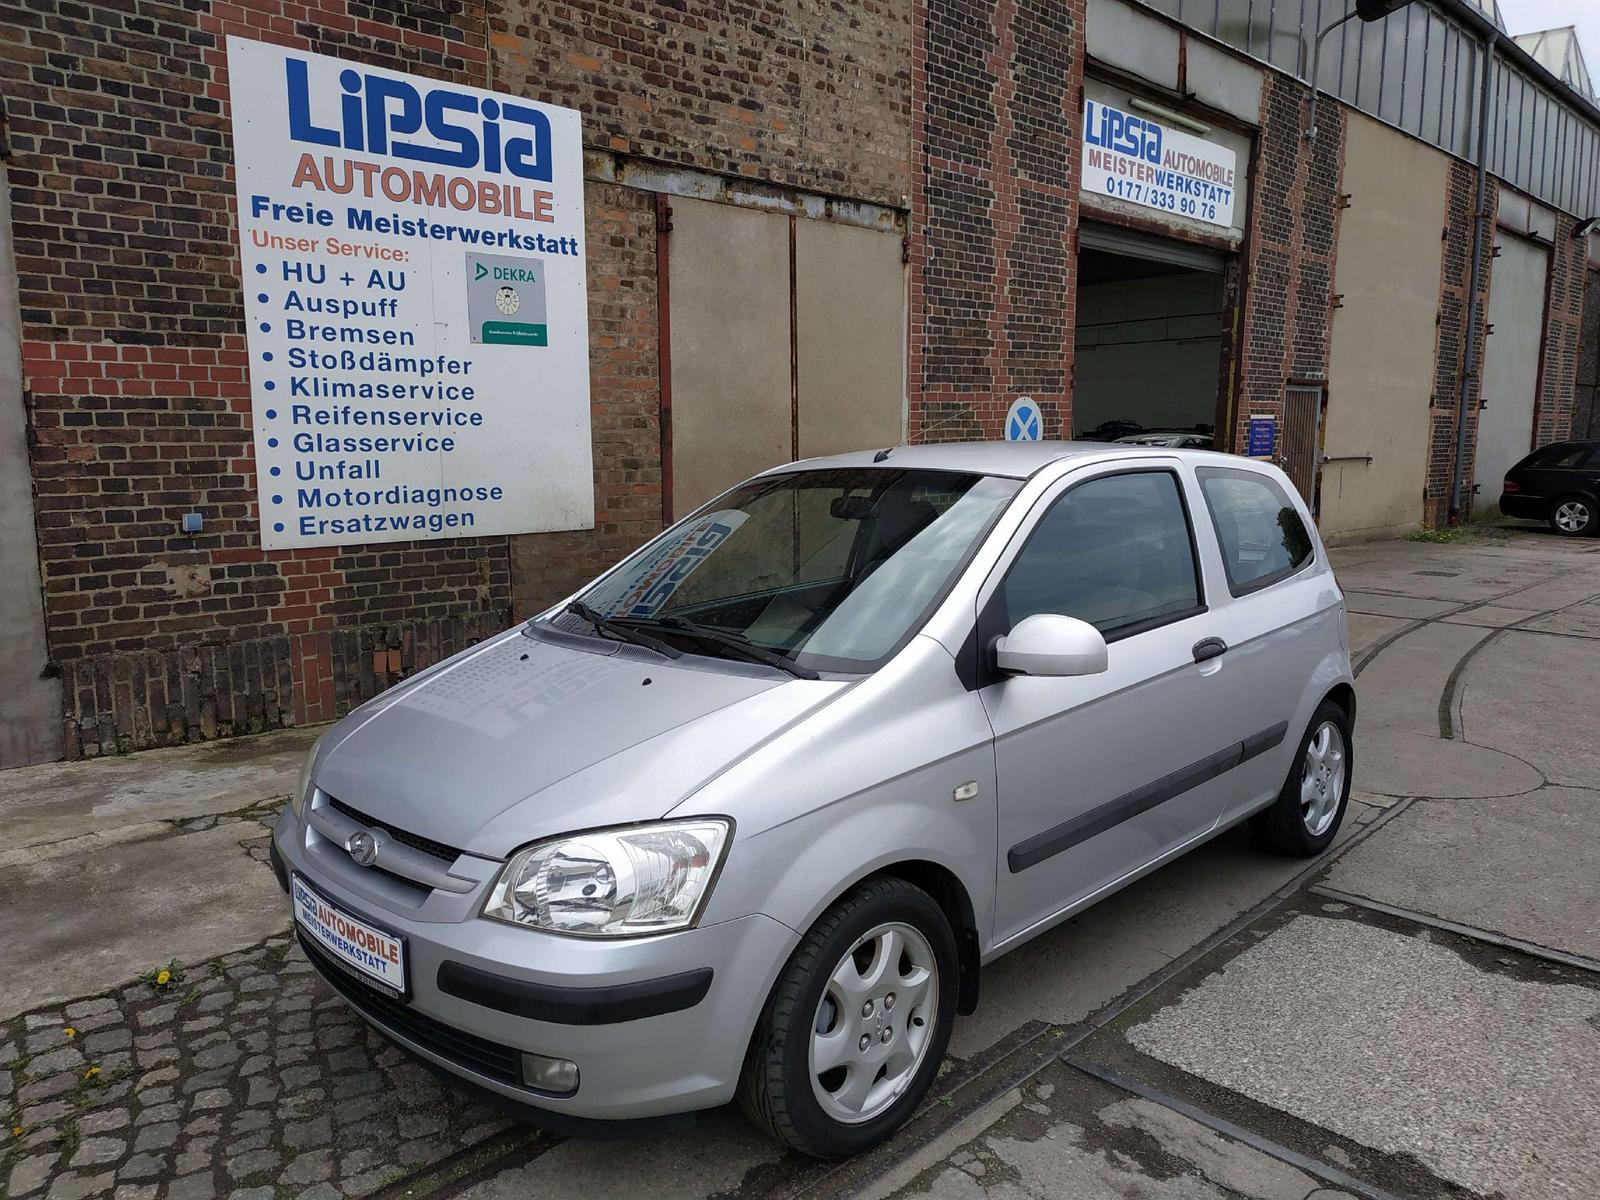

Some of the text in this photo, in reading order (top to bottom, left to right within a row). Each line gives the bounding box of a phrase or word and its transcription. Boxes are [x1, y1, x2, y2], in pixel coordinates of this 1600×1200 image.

[1088, 148, 1231, 205] MEISTERWERKSTATT
[1163, 149, 1233, 187] AUTOMOBILE
[291, 153, 555, 223] AUTOMOBILE
[1180, 197, 1196, 215] 90
[1201, 202, 1216, 220] 76
[251, 195, 579, 256] Freie Meisterwerkstatt
[252, 229, 410, 263] Unser Service:
[282, 260, 326, 285] HU
[366, 269, 406, 291] AU
[493, 266, 536, 283] DEKRA
[283, 290, 399, 319] Auspuff
[286, 318, 415, 346] Bremsen
[288, 347, 473, 377] Stoßdämpfer
[290, 376, 475, 401] Klimaservice
[291, 404, 484, 426] Reifenservice
[293, 432, 456, 453] Glasservice
[295, 459, 381, 481] Unfall
[297, 485, 503, 509] Motordiagnose
[299, 510, 476, 536] Ersatzwagen
[302, 908, 388, 974] MEISTERWERKSTATT
[318, 904, 399, 965] AUTOMOBILE
